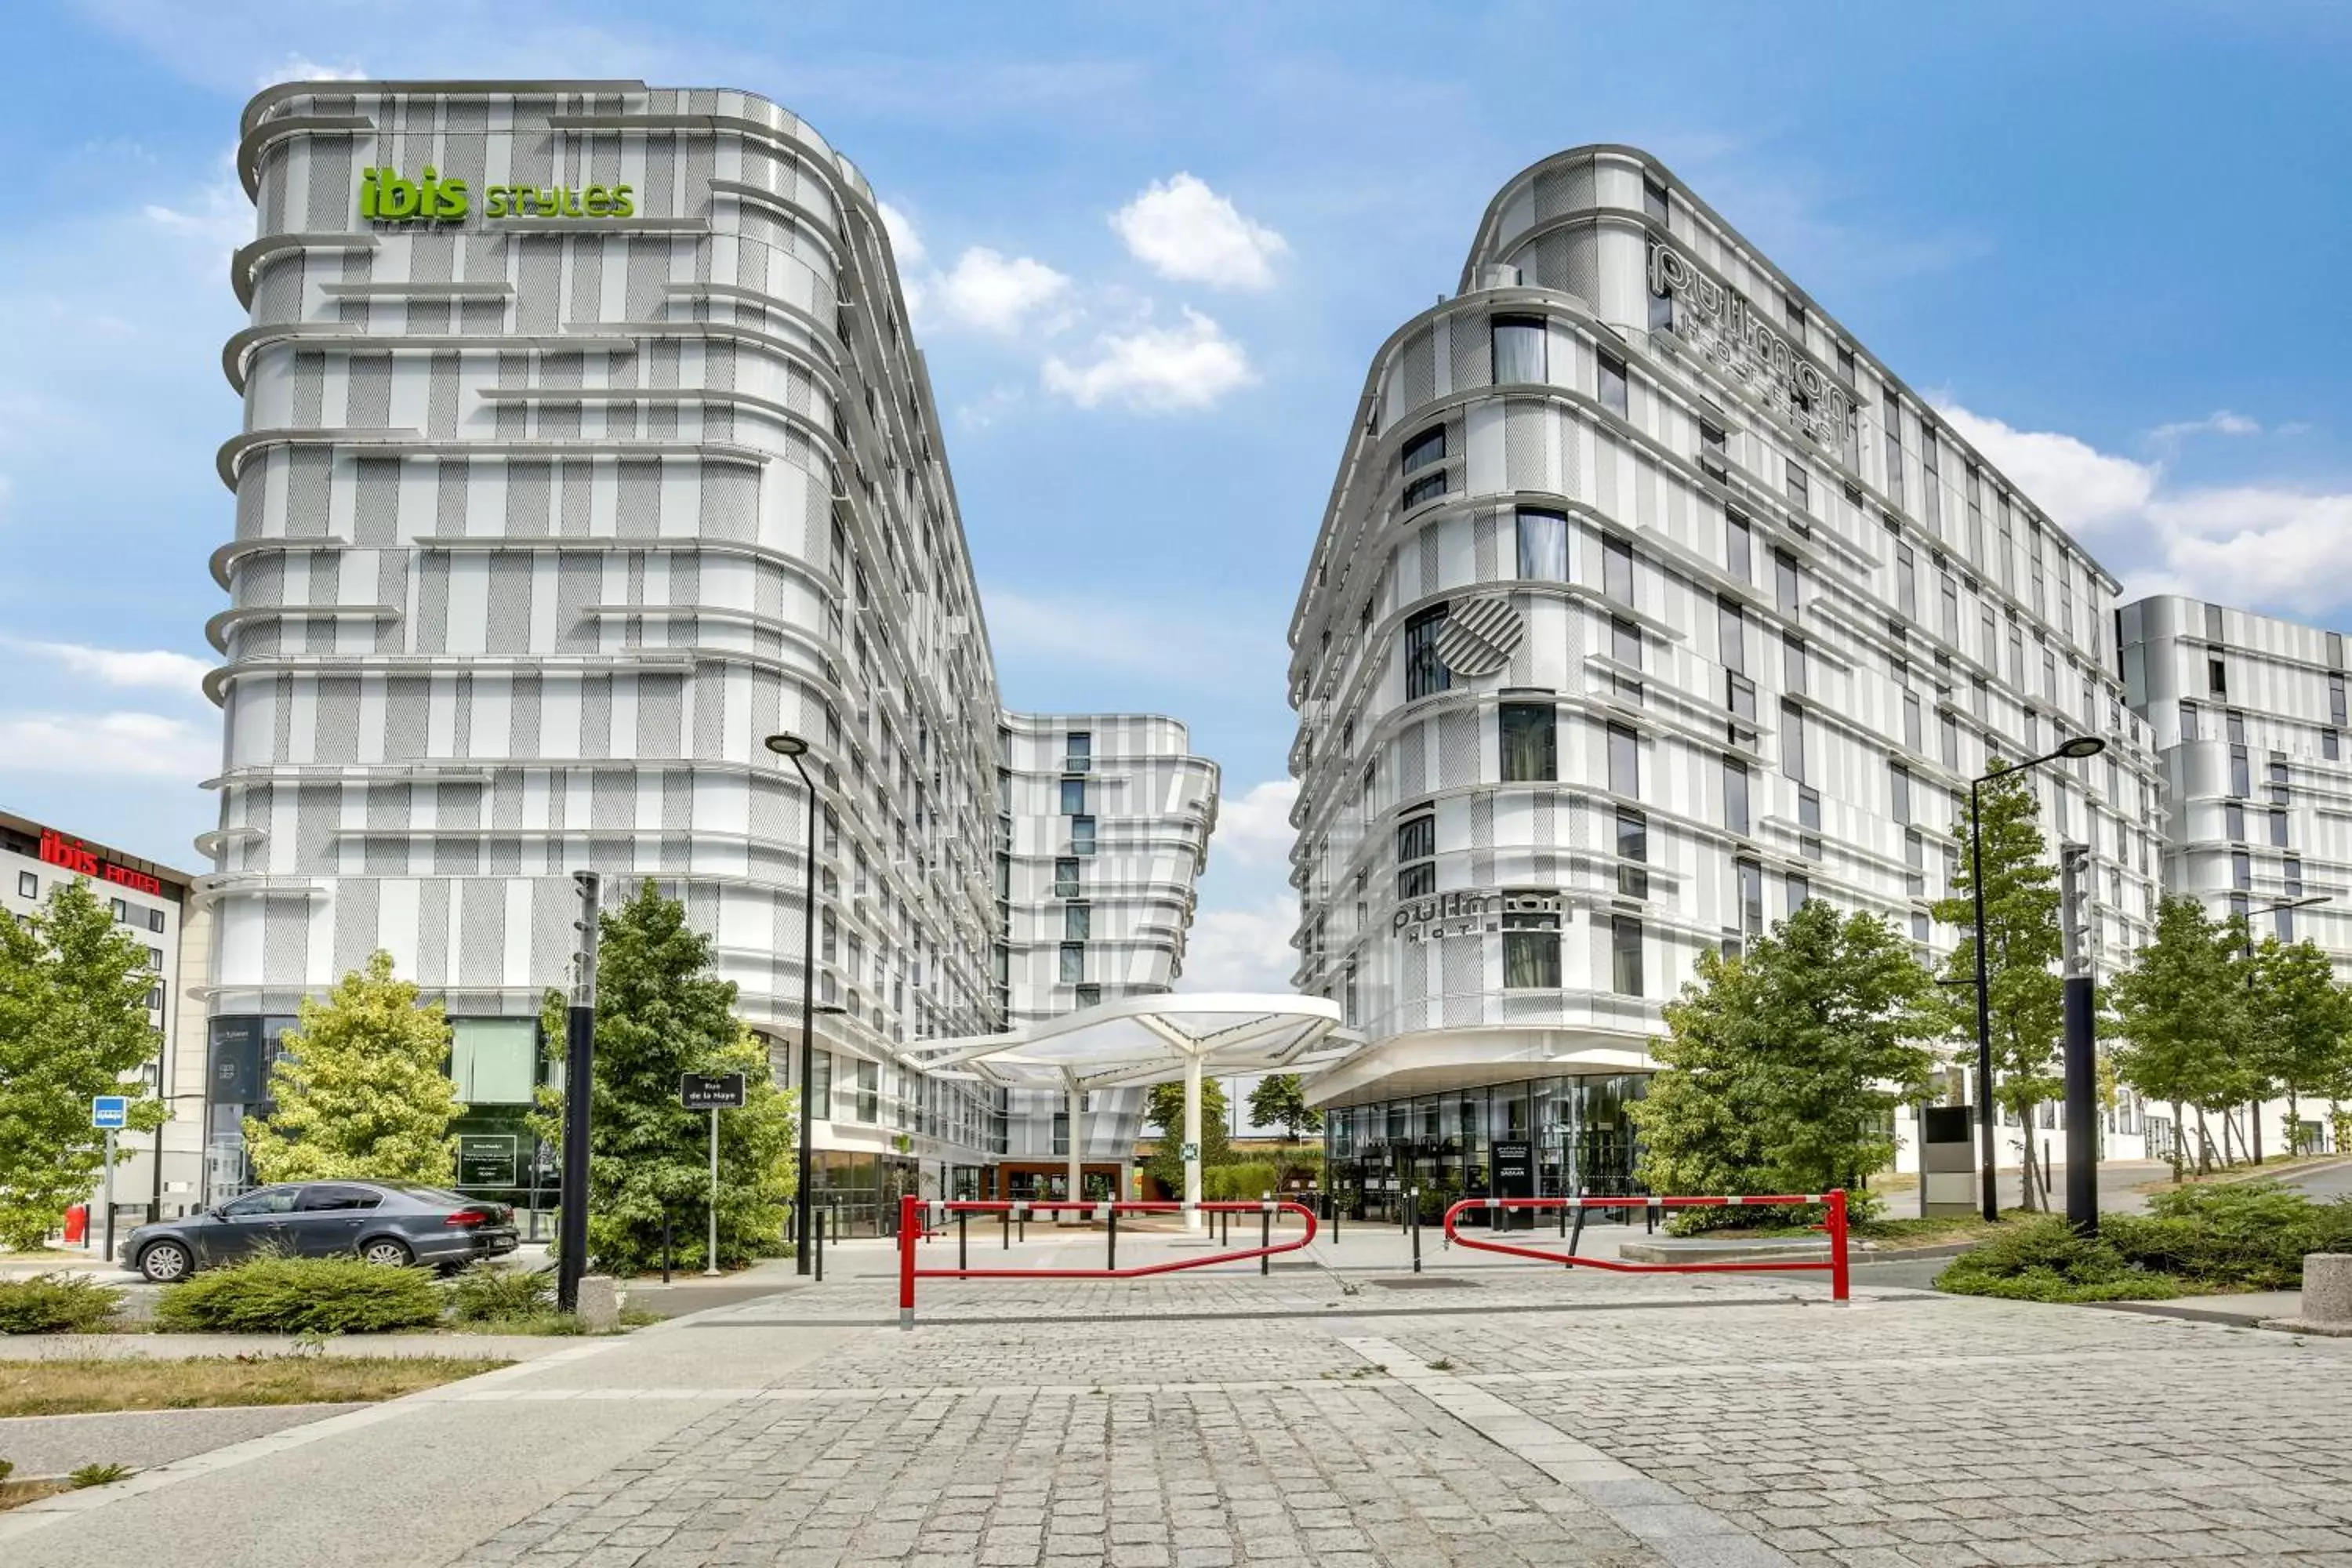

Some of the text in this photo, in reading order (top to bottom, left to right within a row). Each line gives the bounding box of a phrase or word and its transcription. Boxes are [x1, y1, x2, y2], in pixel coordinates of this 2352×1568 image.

[359, 164, 469, 220] ibis
[1650, 244, 1857, 440] pullman
[40, 828, 98, 877] ibis
[1392, 893, 1573, 938] pullman
